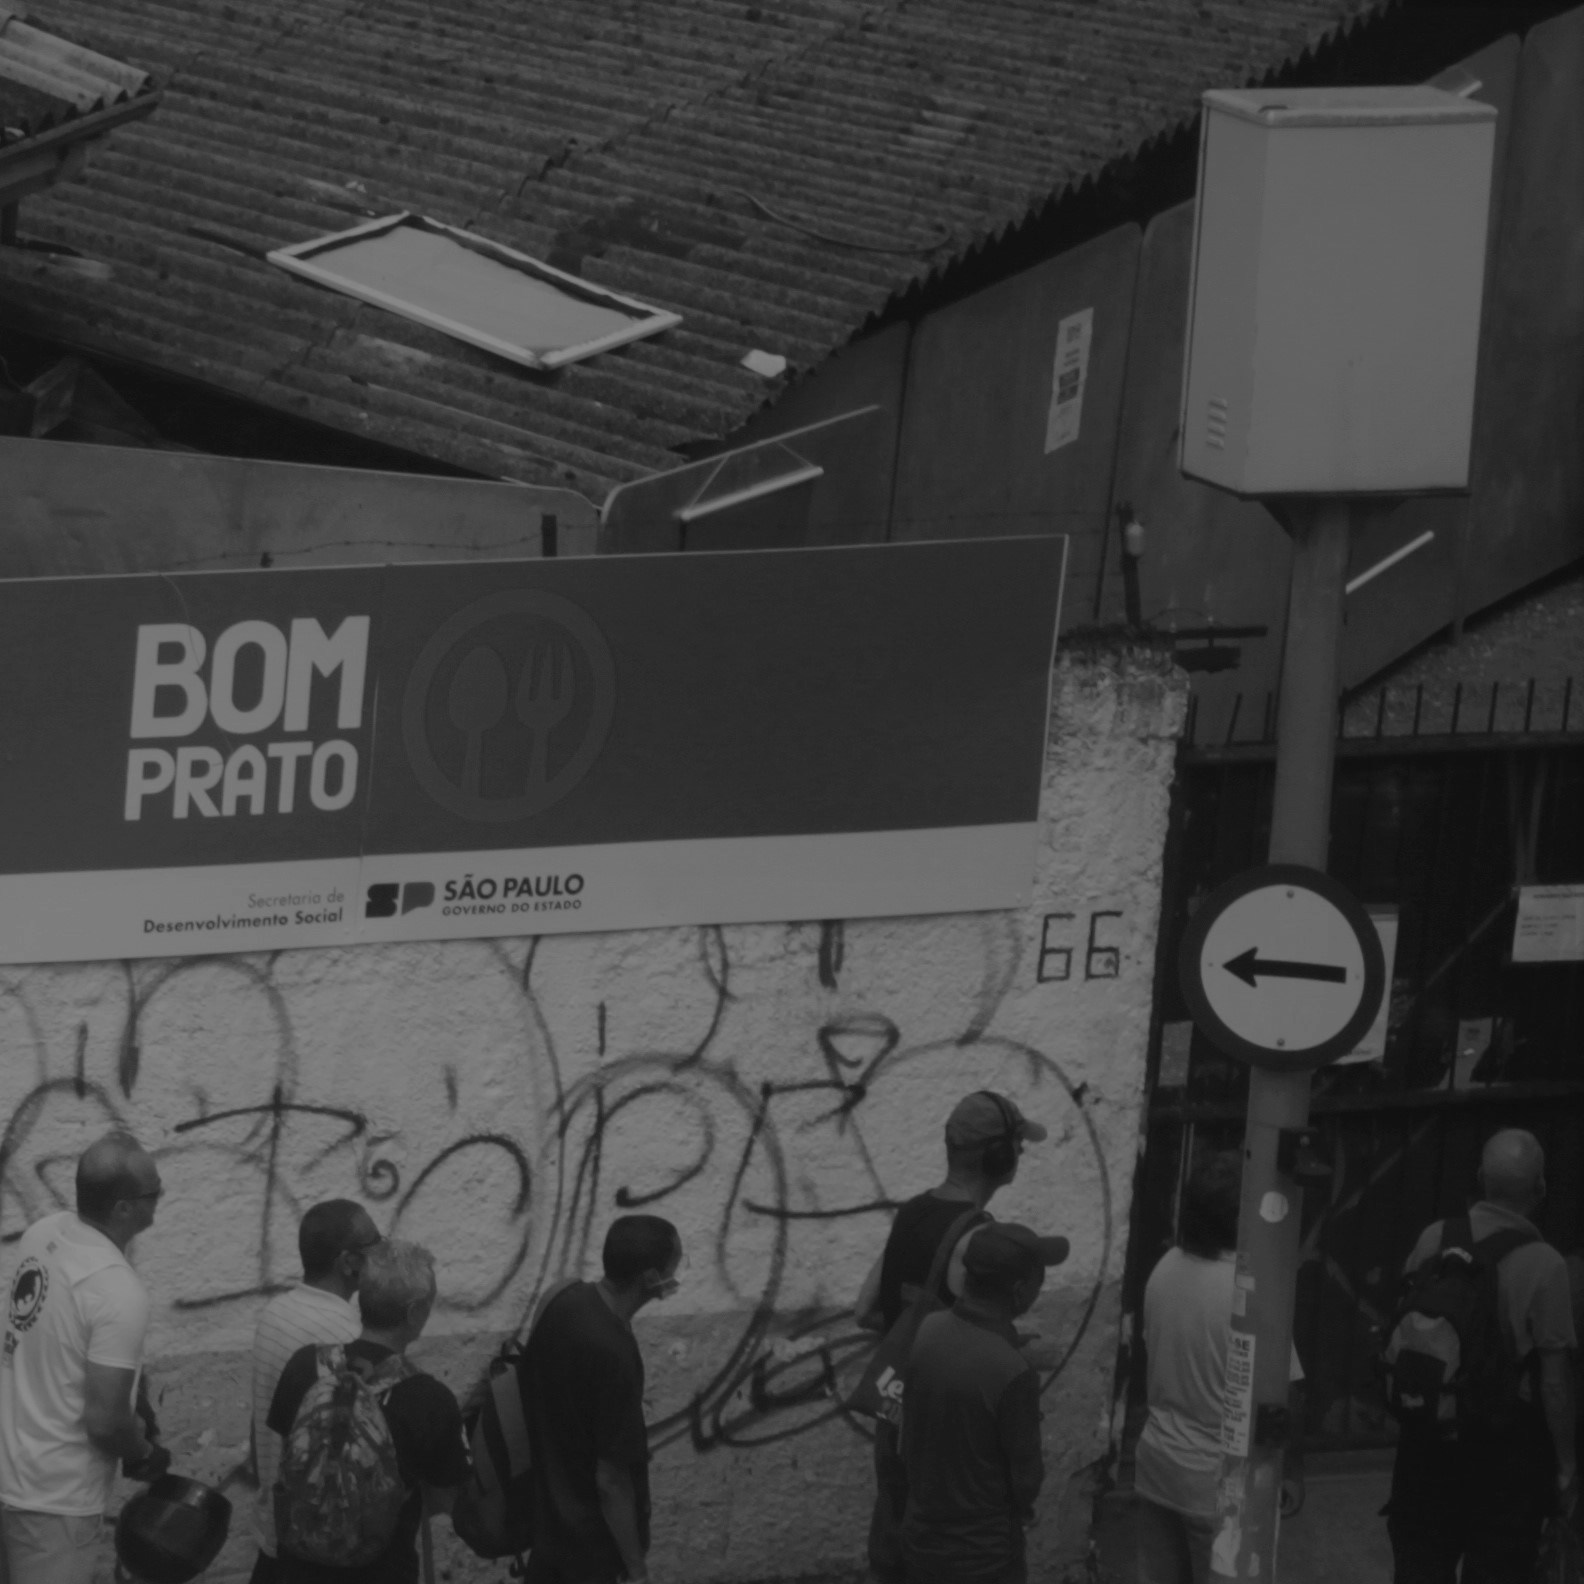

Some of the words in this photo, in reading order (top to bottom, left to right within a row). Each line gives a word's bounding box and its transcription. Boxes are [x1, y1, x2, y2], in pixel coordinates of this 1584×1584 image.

[129, 614, 371, 740] BOM
[124, 739, 360, 822] PRATO
[247, 890, 322, 909] Secretaria
[327, 886, 345, 904] de
[444, 873, 497, 901] SÃO
[503, 873, 585, 898] PAULO
[143, 913, 289, 934] Desenvolvimento
[294, 906, 344, 925] Social
[442, 903, 506, 917] GOVERNO
[511, 901, 530, 913] DO
[534, 898, 582, 912] ESTADO
[1036, 910, 1123, 984] 66
